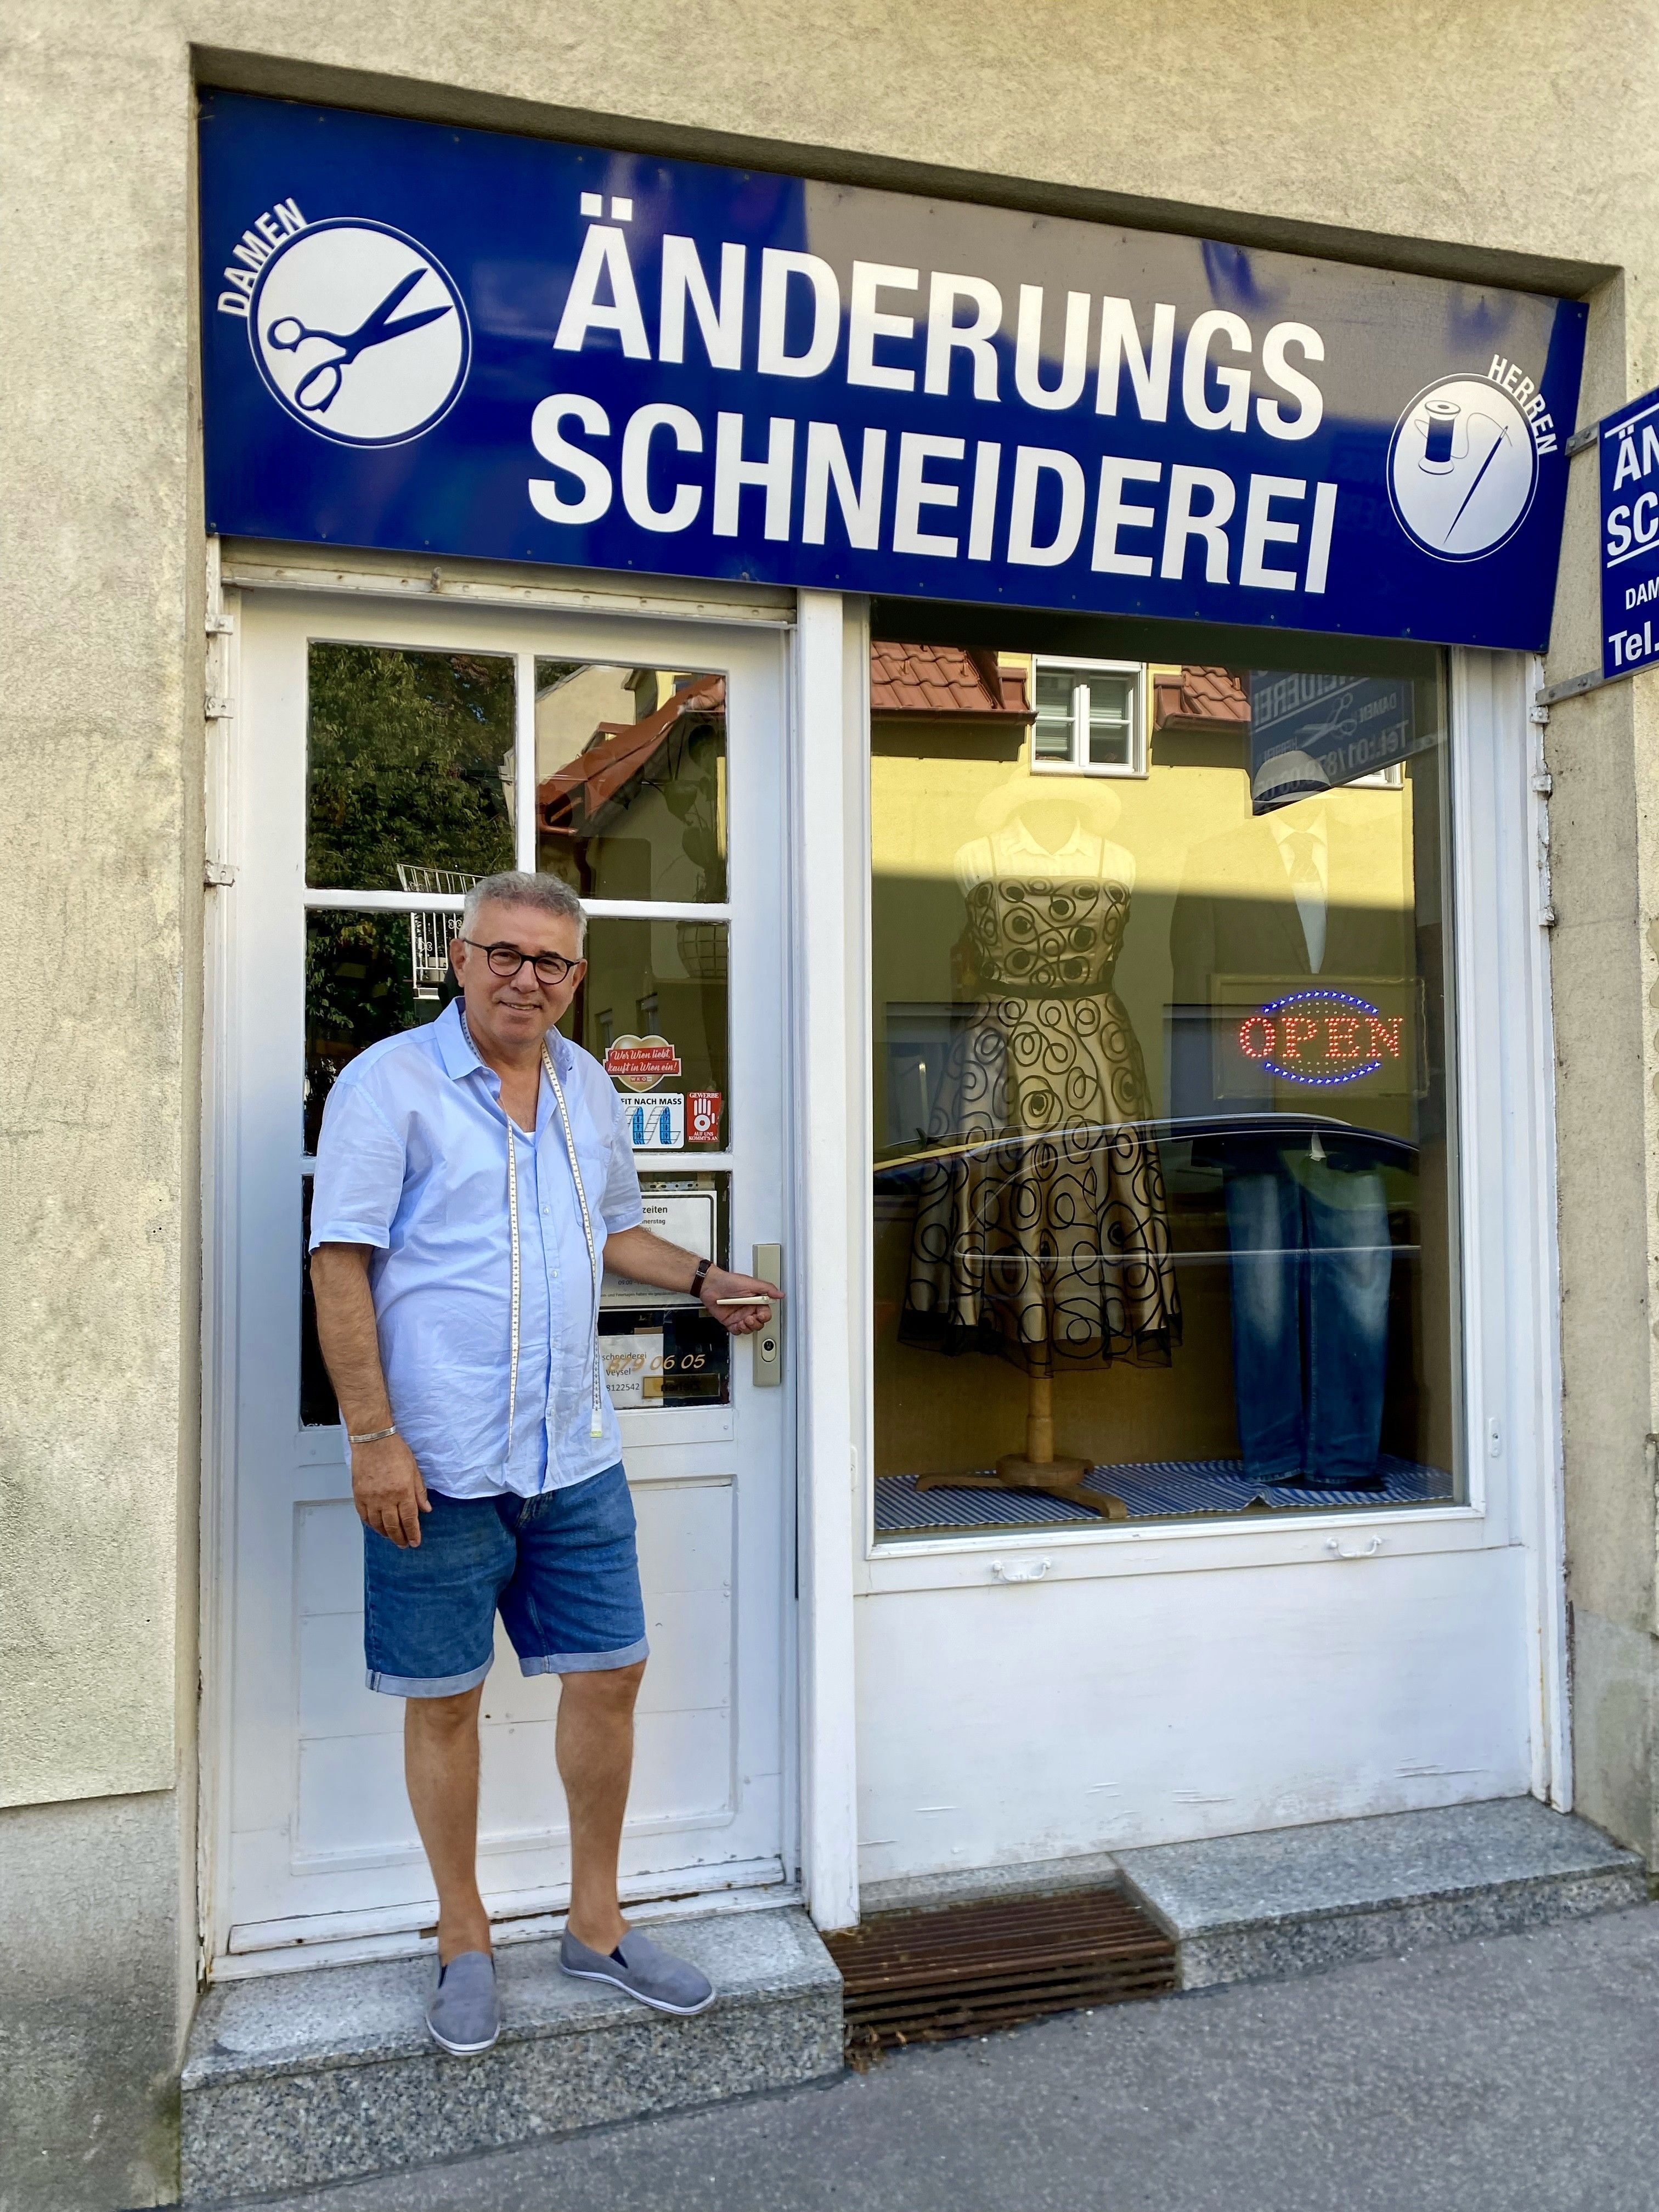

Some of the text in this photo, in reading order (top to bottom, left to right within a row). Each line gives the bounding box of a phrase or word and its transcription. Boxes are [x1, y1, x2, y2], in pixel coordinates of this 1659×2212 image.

[217, 198, 307, 318] DAMEN
[553, 192, 1324, 440] ÄNDERUNGS
[1488, 354, 1558, 455] HERREN
[1613, 424, 1659, 492] ÄN
[529, 393, 1338, 593] SCHNEIDEREI
[1607, 491, 1659, 556] SC
[607, 1062, 678, 1074] kauft in Wien ein!
[610, 1050, 629, 1060] Wer
[630, 1049, 651, 1059] Wien
[1239, 1016, 1404, 1058] OPEN
[606, 1368, 631, 1377] Veysel
[650, 1355, 675, 1370] 06
[681, 1354, 706, 1369] 05
